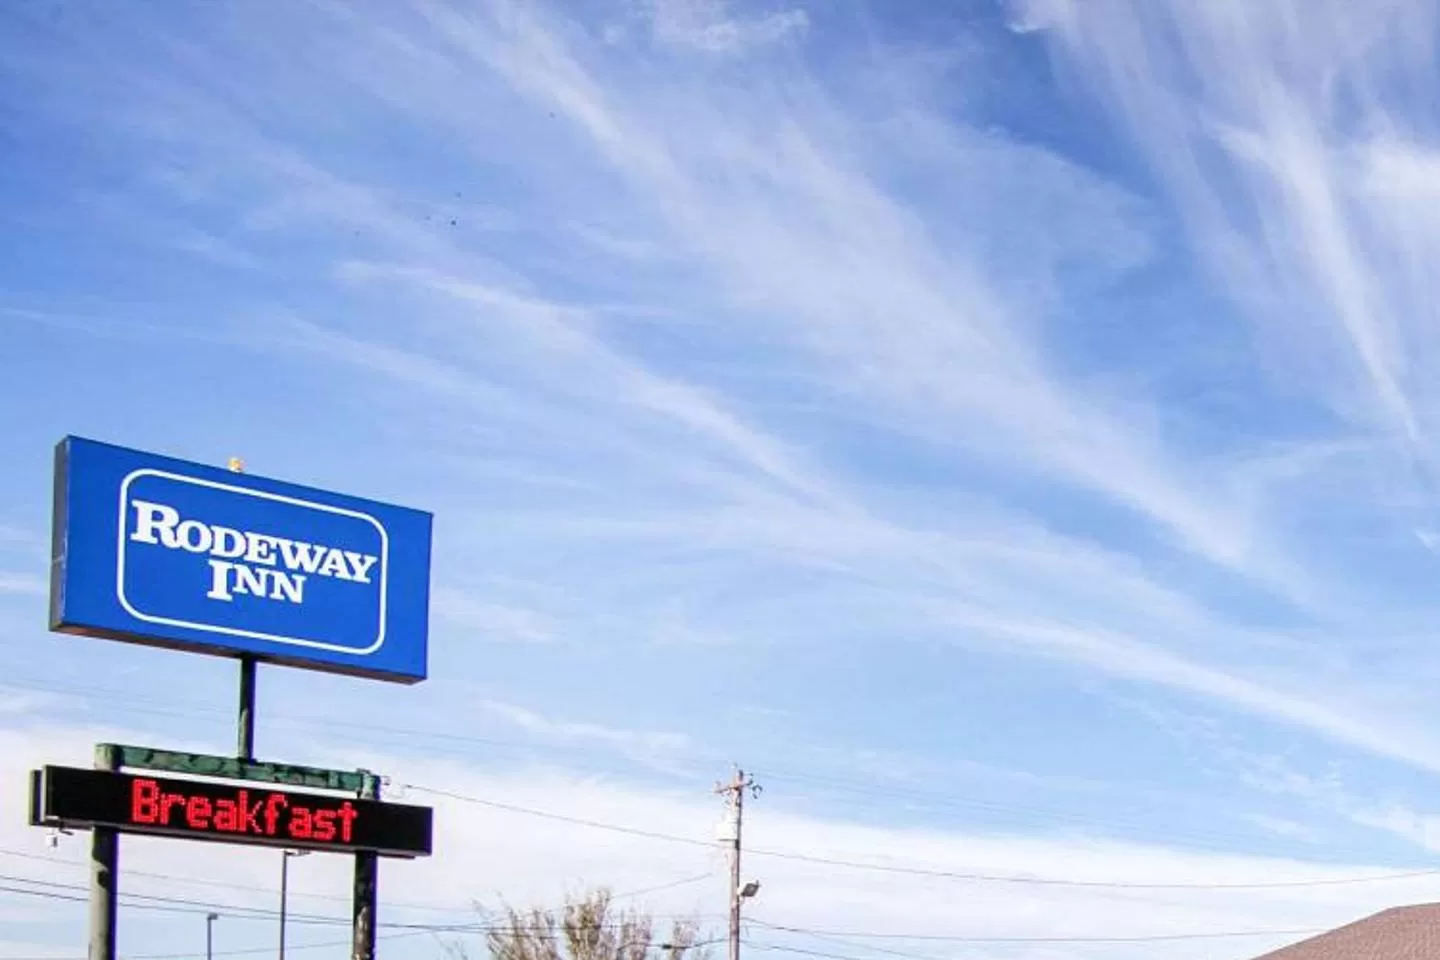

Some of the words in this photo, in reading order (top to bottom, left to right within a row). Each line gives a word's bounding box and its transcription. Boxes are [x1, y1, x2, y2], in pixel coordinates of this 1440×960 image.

[130, 500, 377, 583] RODEWAY
[207, 559, 306, 604] INN
[132, 778, 358, 842] Breakfast
